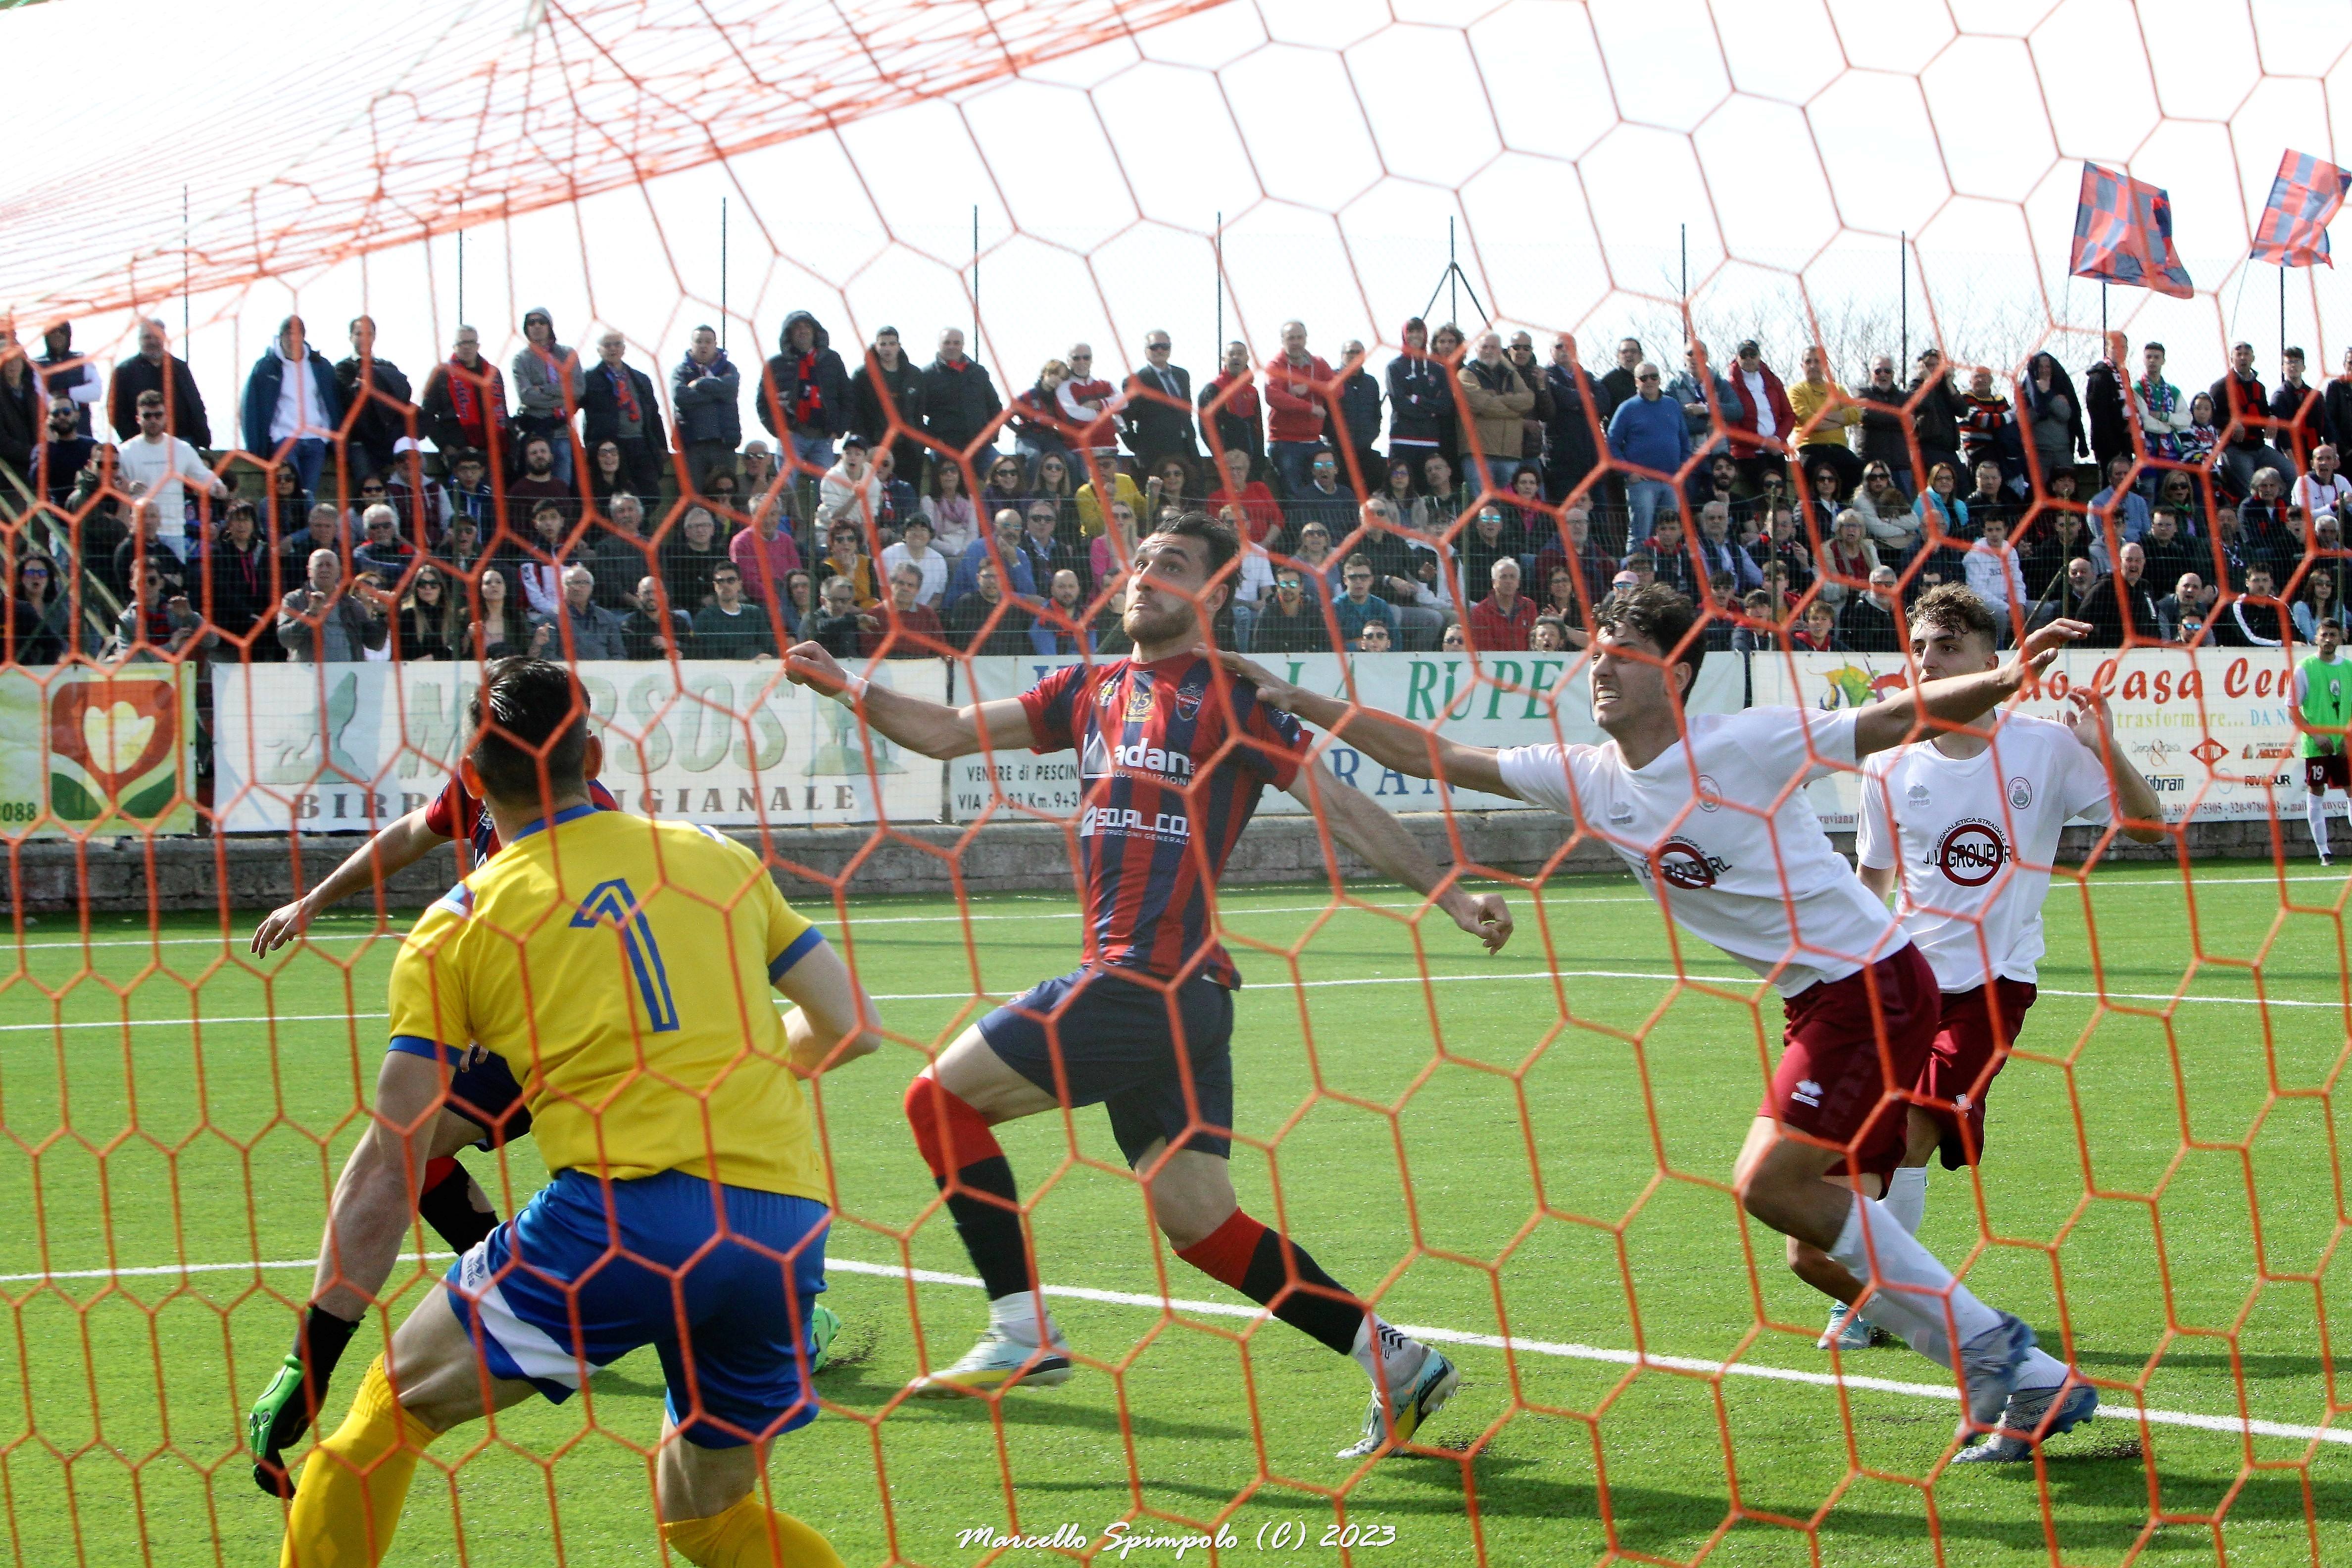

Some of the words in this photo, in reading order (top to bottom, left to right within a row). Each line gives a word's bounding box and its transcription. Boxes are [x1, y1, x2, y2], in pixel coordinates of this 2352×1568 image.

[1406, 661, 1564, 721] RUPE
[2091, 658, 2203, 704] Casa
[2250, 708, 2271, 727] DA
[1018, 764, 1029, 781] di
[1036, 764, 1078, 781] PESCIN
[2312, 765, 2323, 781] 19
[958, 794, 981, 809] VIA
[1937, 818, 1977, 848] SEGNALETICA
[1976, 818, 2007, 844] STRADALE
[1947, 843, 1996, 868] GROUP
[569, 878, 680, 1032] 1
